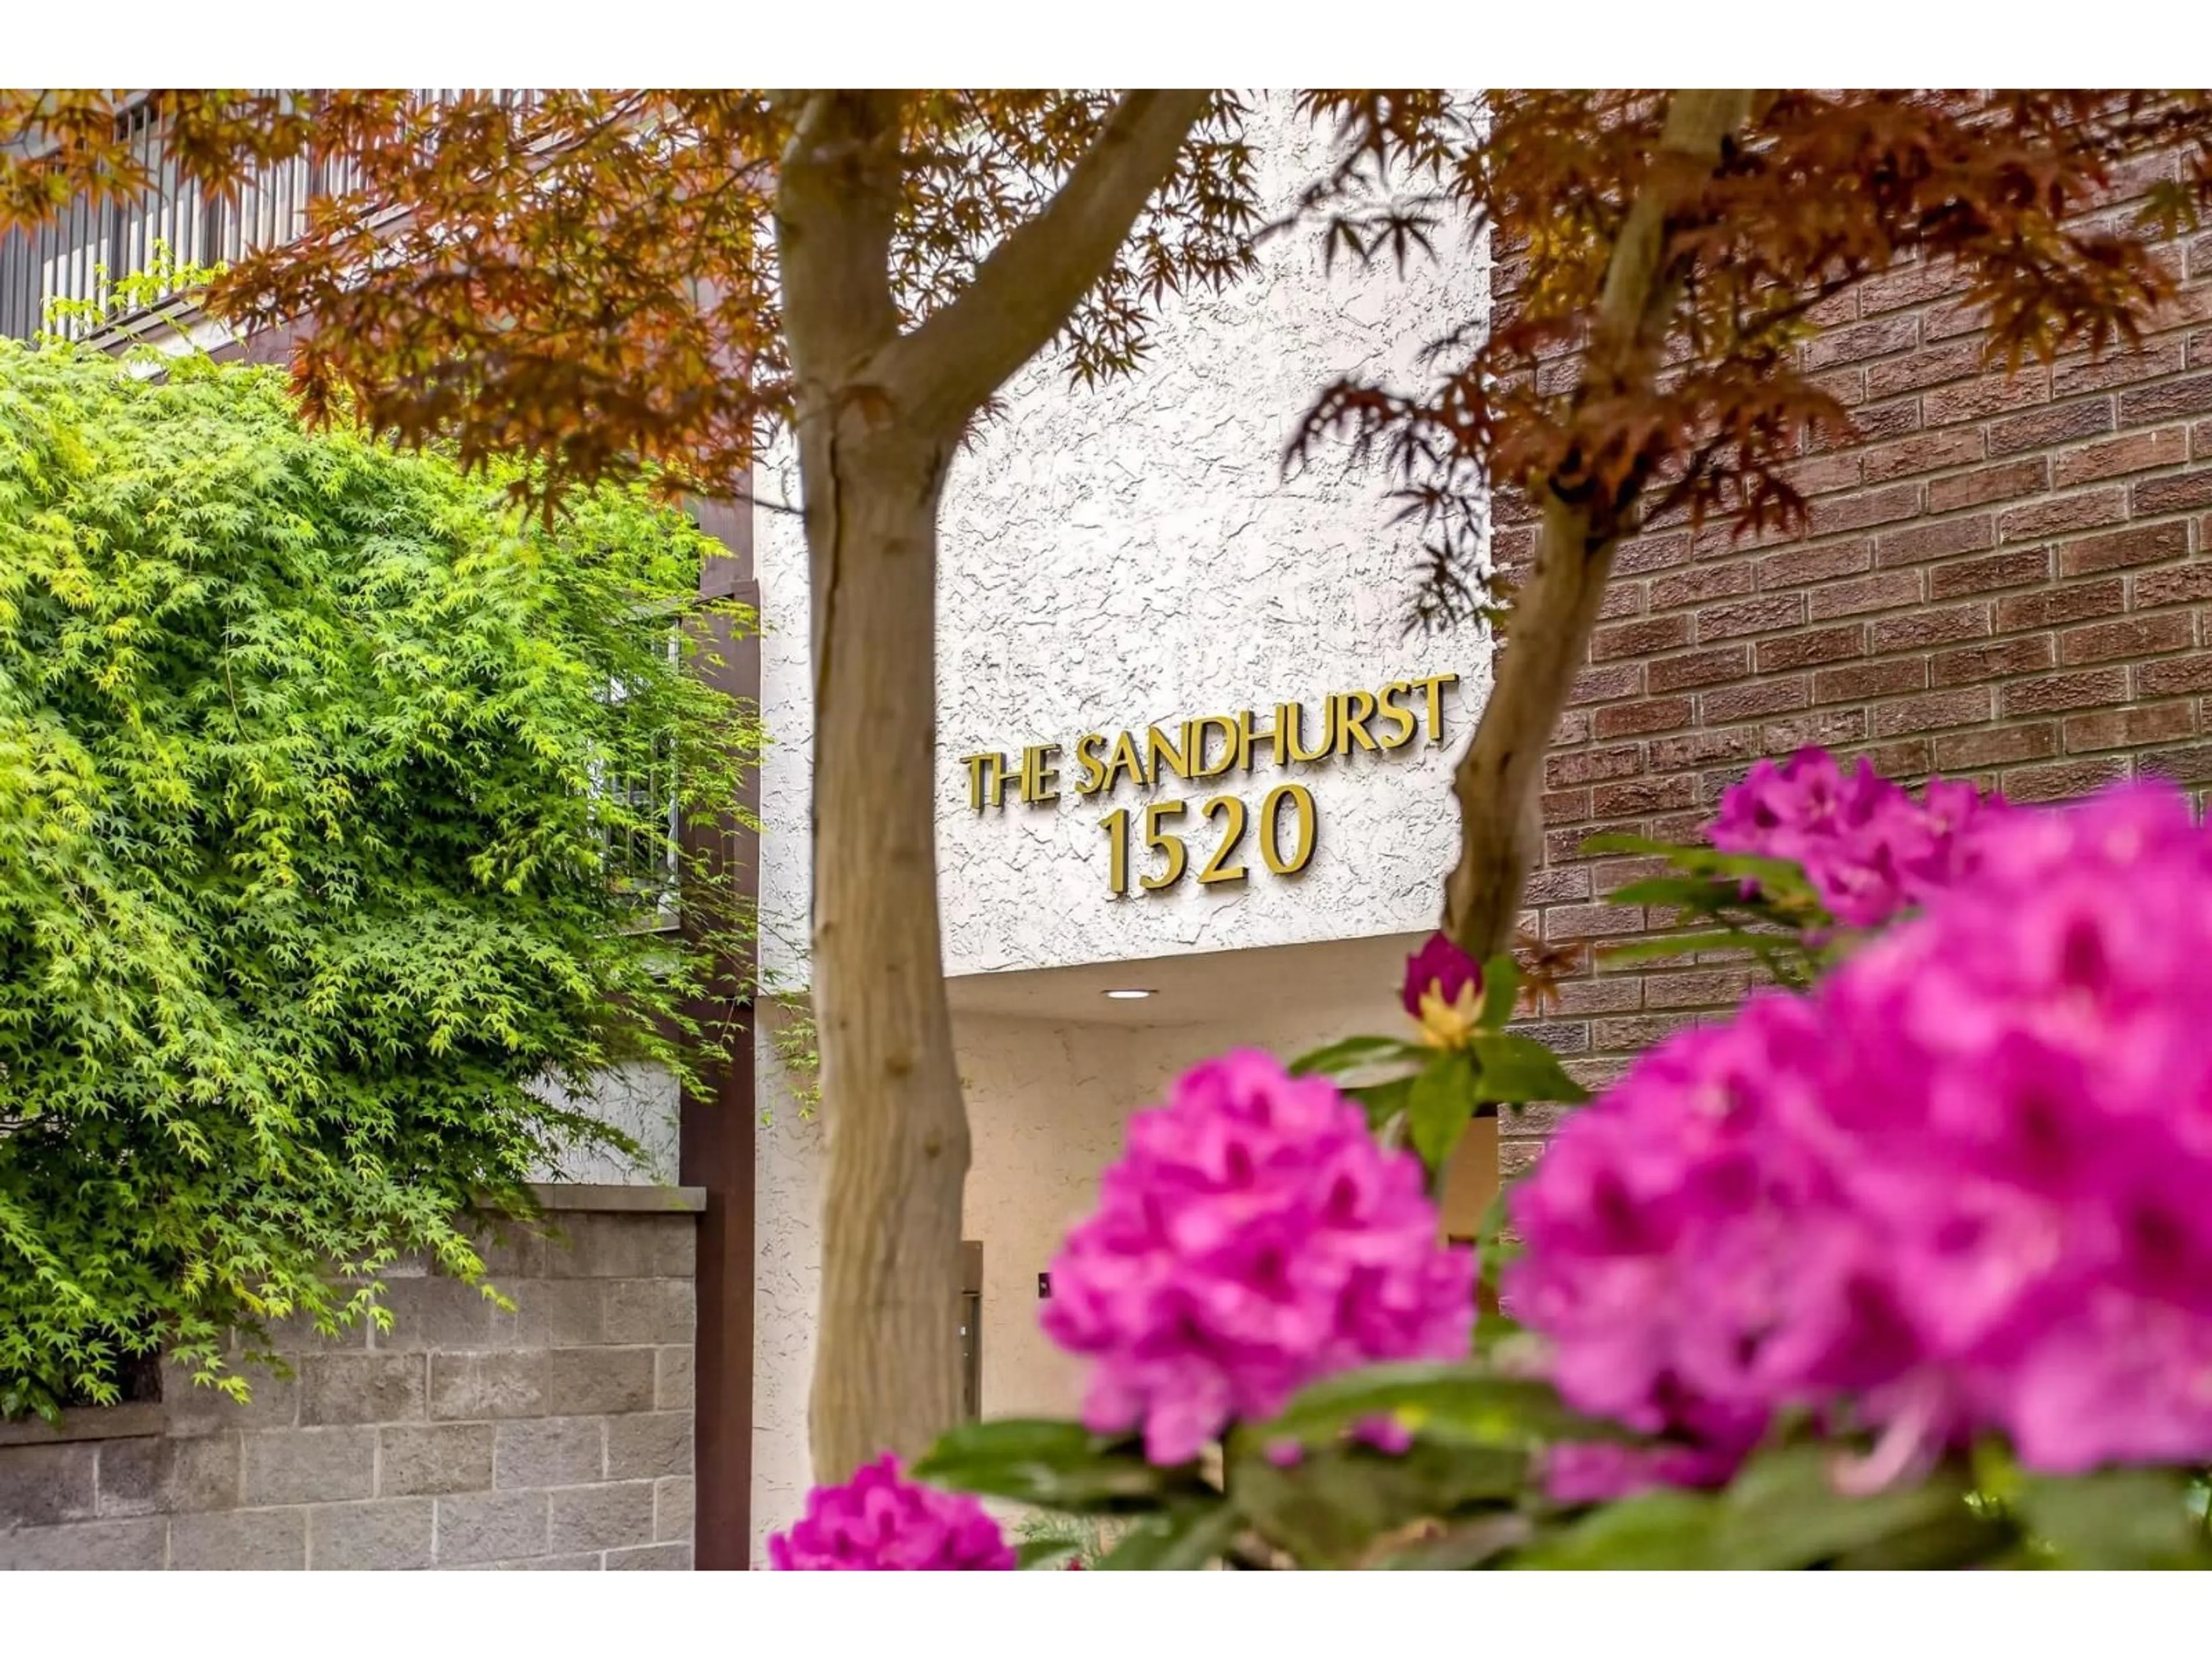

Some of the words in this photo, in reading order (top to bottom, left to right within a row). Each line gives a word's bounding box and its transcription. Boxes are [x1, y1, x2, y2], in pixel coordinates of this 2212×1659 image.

[960, 743, 1062, 809] THE
[1075, 673, 1459, 794] SANDHURST
[1100, 784, 1317, 894] 1520
